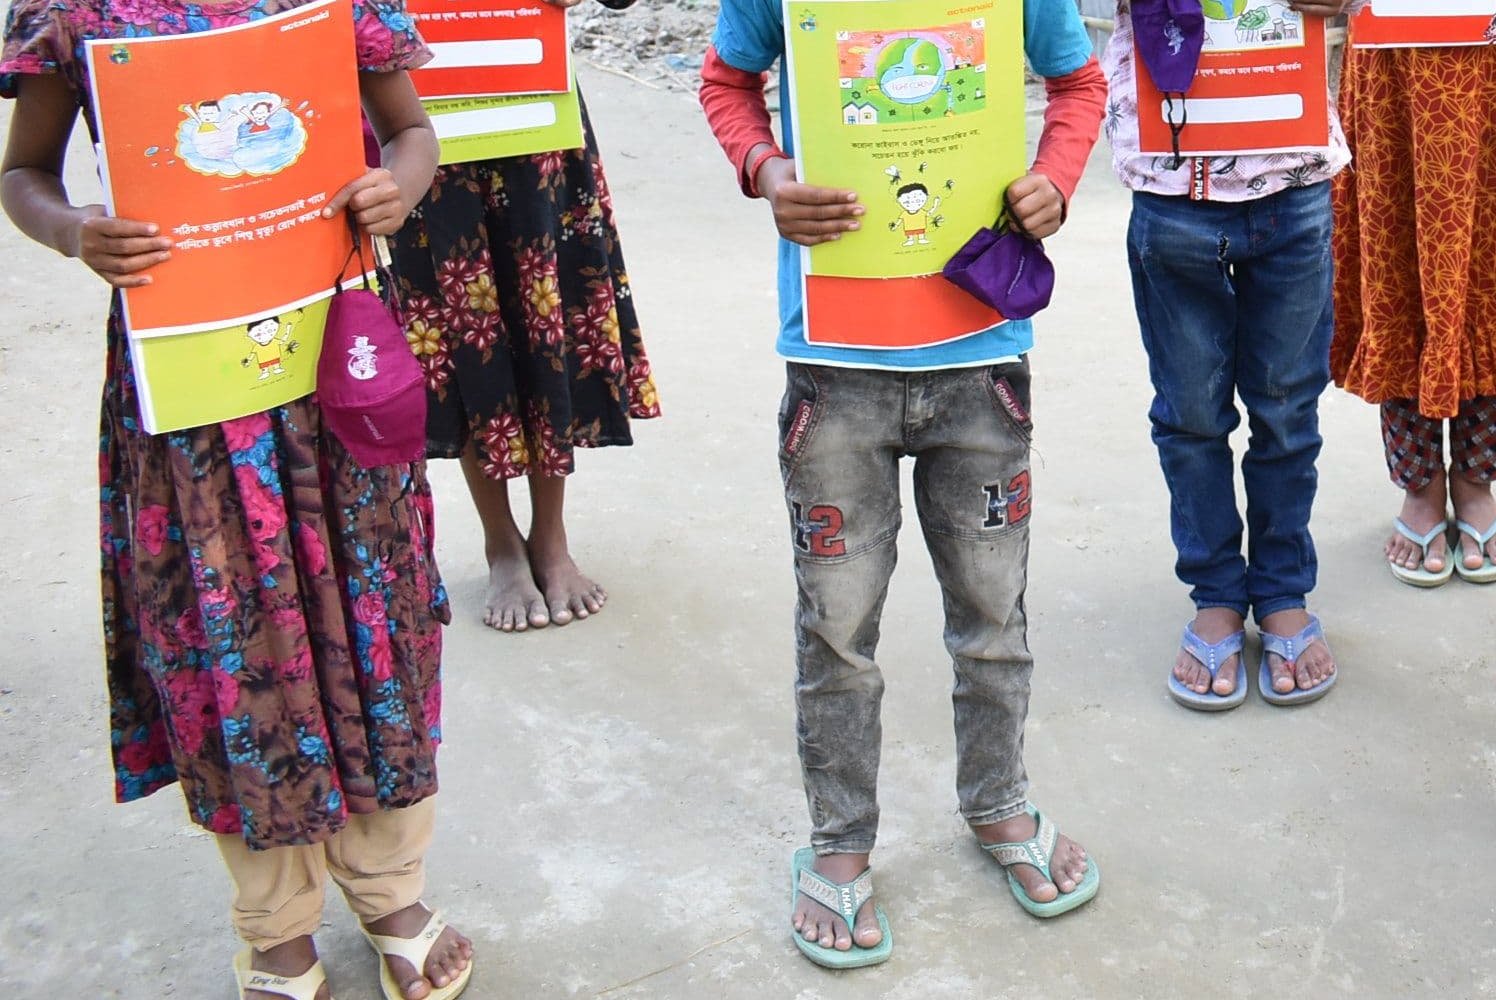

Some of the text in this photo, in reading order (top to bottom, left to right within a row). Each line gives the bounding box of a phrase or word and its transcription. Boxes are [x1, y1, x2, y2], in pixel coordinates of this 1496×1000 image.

[173, 223, 200, 236] সঠিক
[248, 215, 256, 223] ও
[841, 887, 853, 915] KHAN
